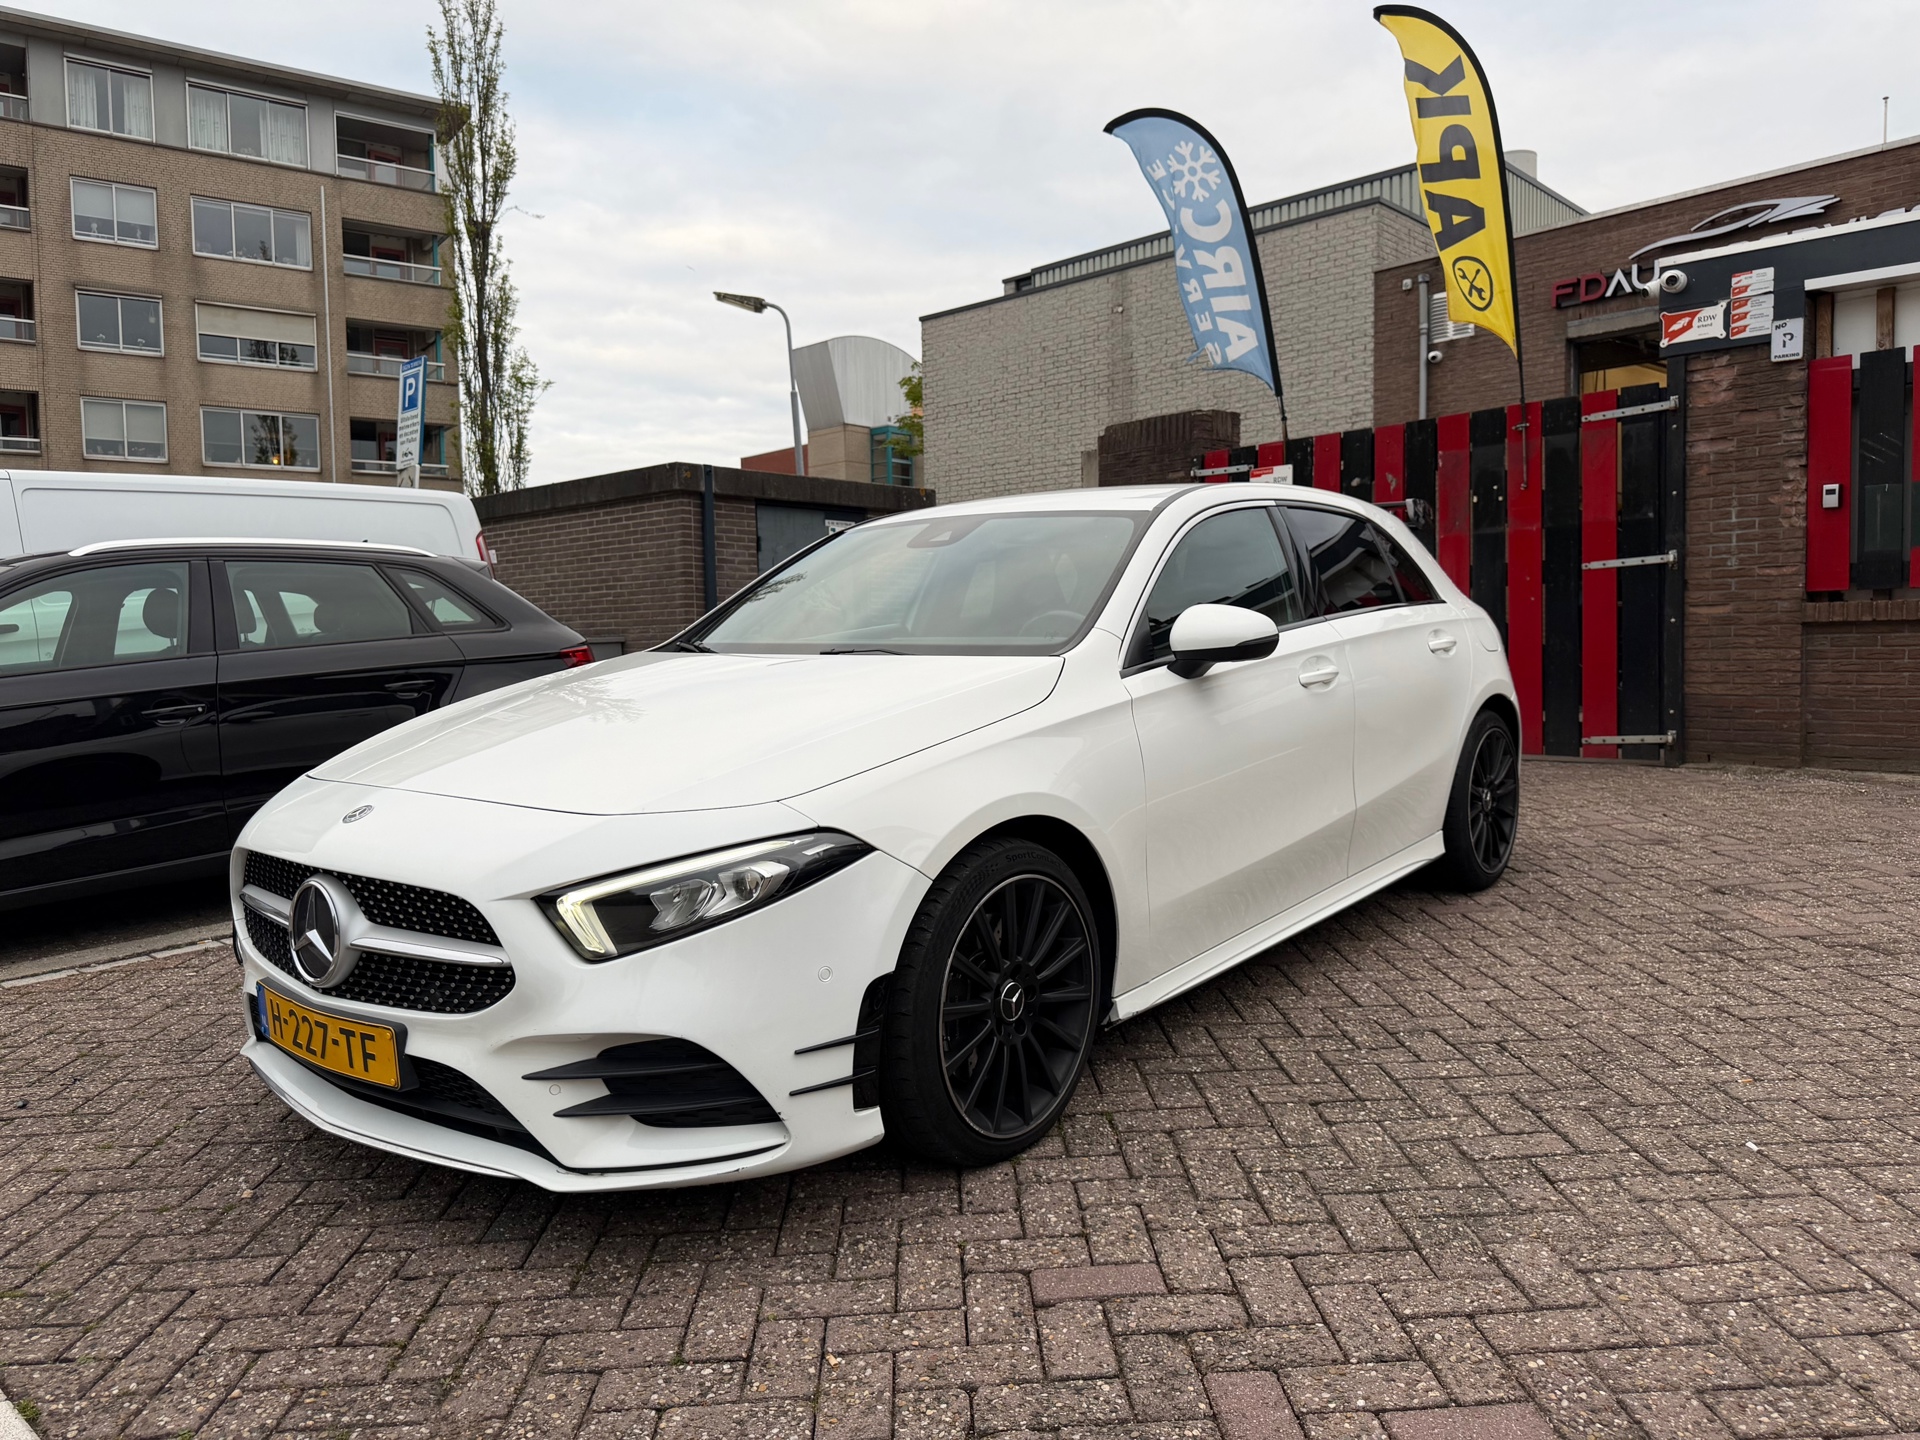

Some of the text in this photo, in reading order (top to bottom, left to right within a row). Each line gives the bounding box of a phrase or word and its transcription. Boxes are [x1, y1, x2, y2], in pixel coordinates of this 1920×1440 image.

[1697, 314, 1717, 323] RDW
[1775, 322, 1788, 331] NO
[1774, 352, 1800, 360] PARKING
[405, 377, 416, 408] P
[269, 997, 376, 1073] H-227-TF
